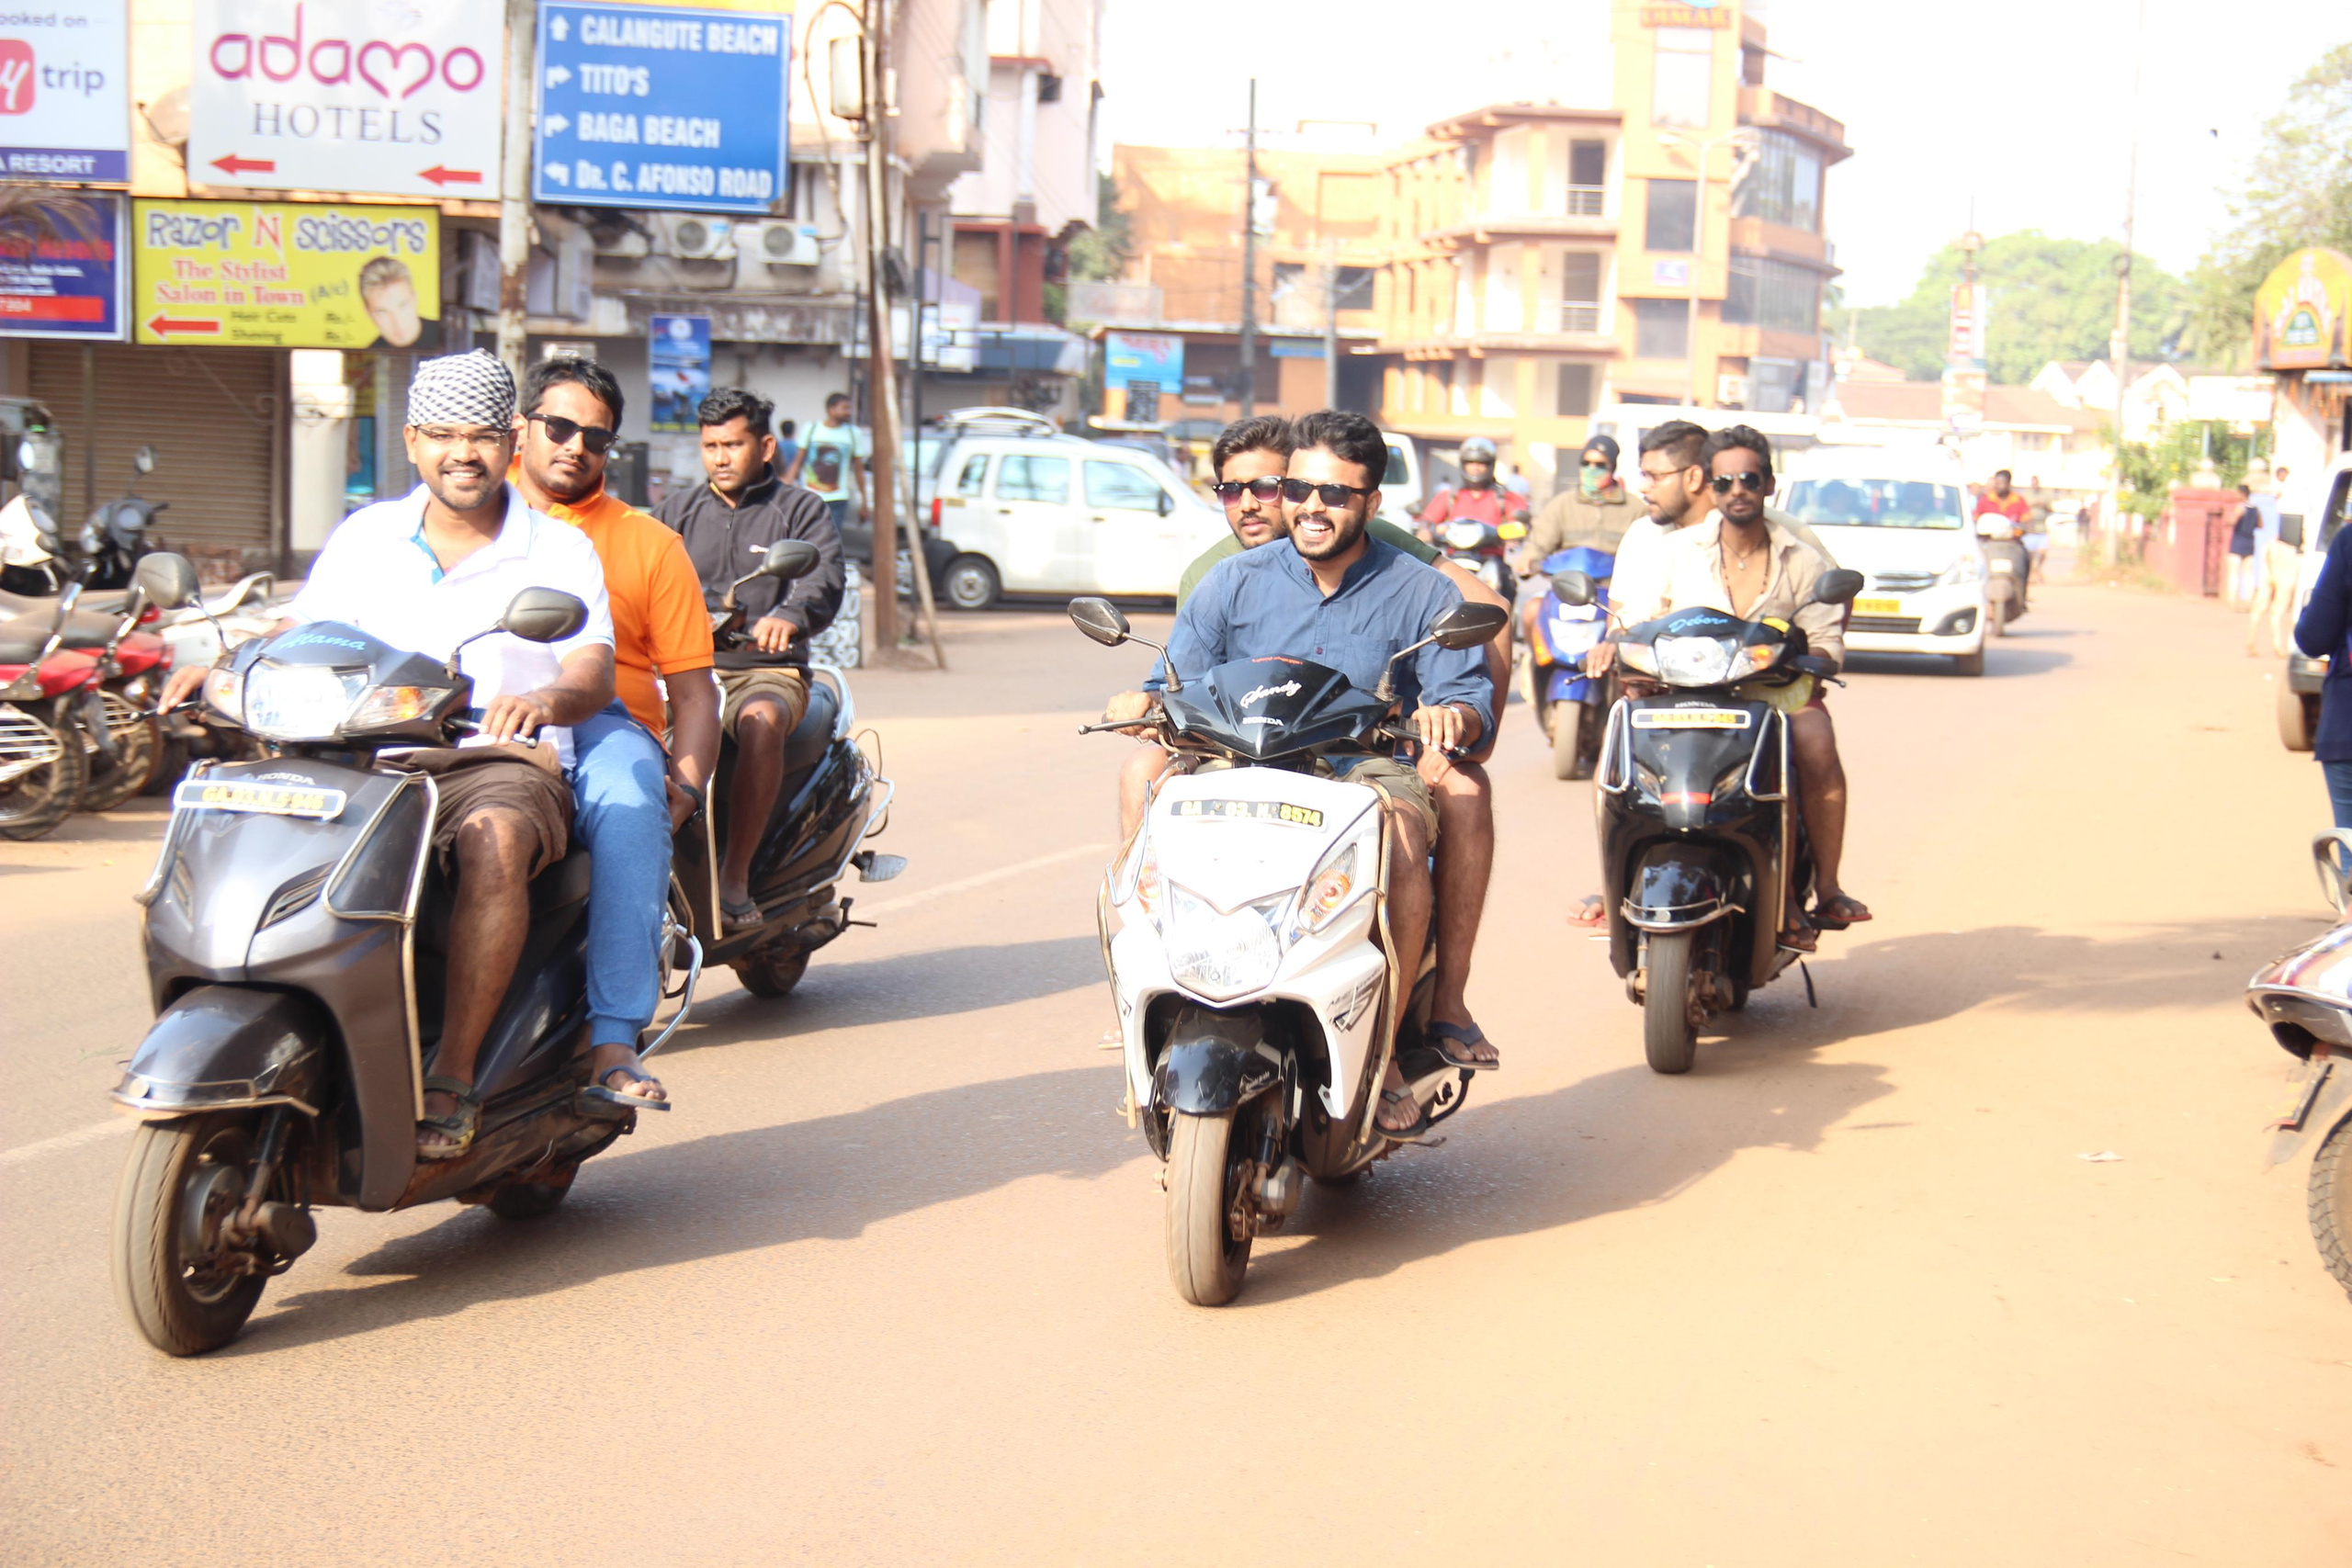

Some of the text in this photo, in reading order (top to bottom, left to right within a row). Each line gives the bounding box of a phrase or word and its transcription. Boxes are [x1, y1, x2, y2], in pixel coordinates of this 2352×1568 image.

[63, 17, 87, 28] on
[580, 15, 777, 55] CALANGUTE BEACH
[209, 2, 485, 98] adamo
[42, 61, 105, 97] trip
[578, 62, 650, 96] TITO'S
[252, 102, 443, 145] HOTELS
[577, 111, 720, 149] BAGA BEACH
[8, 153, 96, 174] RESORT
[638, 163, 715, 196] AFONSO
[718, 167, 773, 199] ROAD
[148, 212, 241, 250] Razor
[254, 214, 282, 250] N
[173, 258, 288, 283] The Stylist
[156, 283, 217, 303] Salon
[223, 285, 244, 305] in
[252, 285, 305, 306] Town
[1242, 716, 1284, 727] HONDA
[256, 772, 316, 785] HONDA
[1280, 804, 1322, 828] 8574
